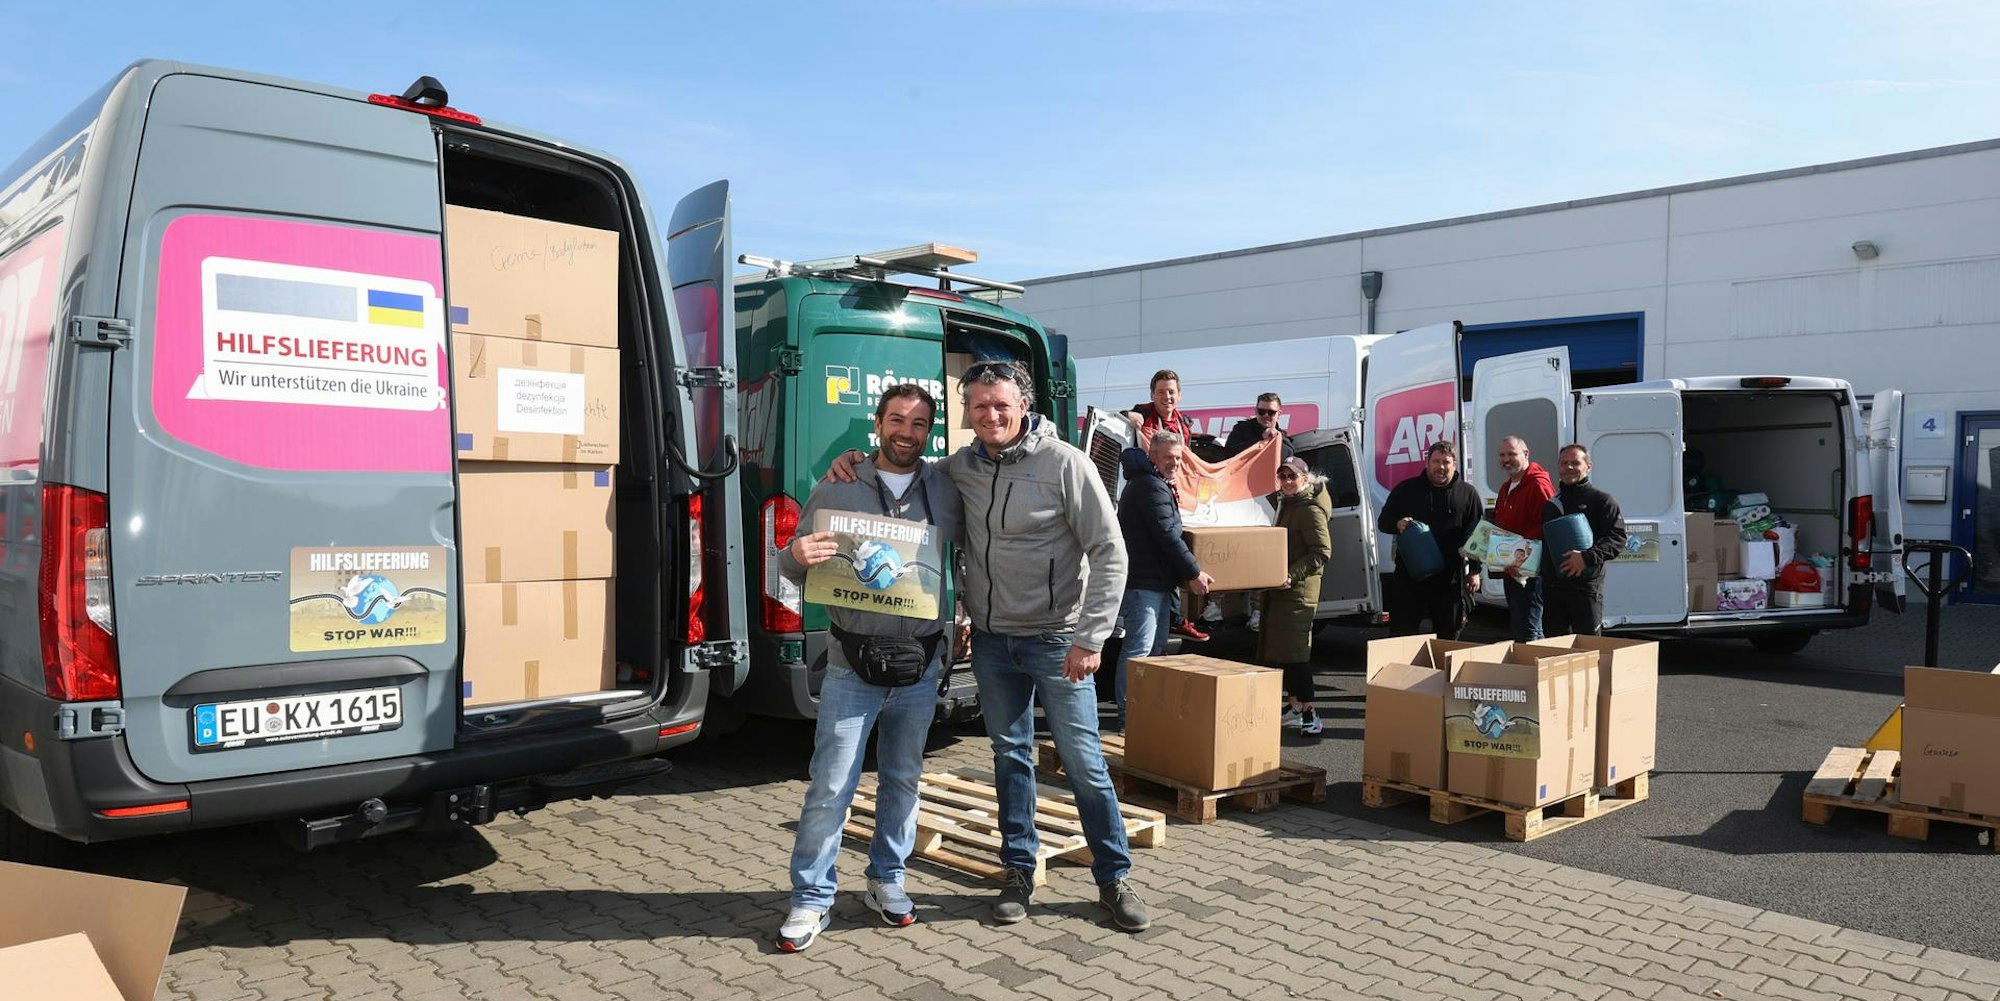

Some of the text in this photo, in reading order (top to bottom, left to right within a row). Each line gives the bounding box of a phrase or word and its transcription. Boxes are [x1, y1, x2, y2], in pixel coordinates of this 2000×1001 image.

[217, 331, 427, 367] HILFSLIEFERUNG
[218, 369, 247, 387] Wir
[251, 372, 347, 393] unterstützen
[351, 379, 372, 395] die
[376, 379, 428, 398] Ukraine
[516, 391, 566, 405] dezynfekcja
[516, 403, 567, 416] Desinfektion
[1922, 417, 1936, 432] 4
[830, 515, 929, 546] HILFSLIEFERUNG
[310, 552, 429, 571] HILFSLIEFERUNG
[136, 571, 282, 587] SPRINTER
[833, 588, 914, 609] STOP WAR!!!
[324, 627, 417, 641] STOP WAR!!!
[1454, 687, 1526, 703] HILFSLIEFERUNG
[220, 693, 398, 737] EU KX 1615
[203, 728, 212, 738] D
[1464, 740, 1488, 750] STOP
